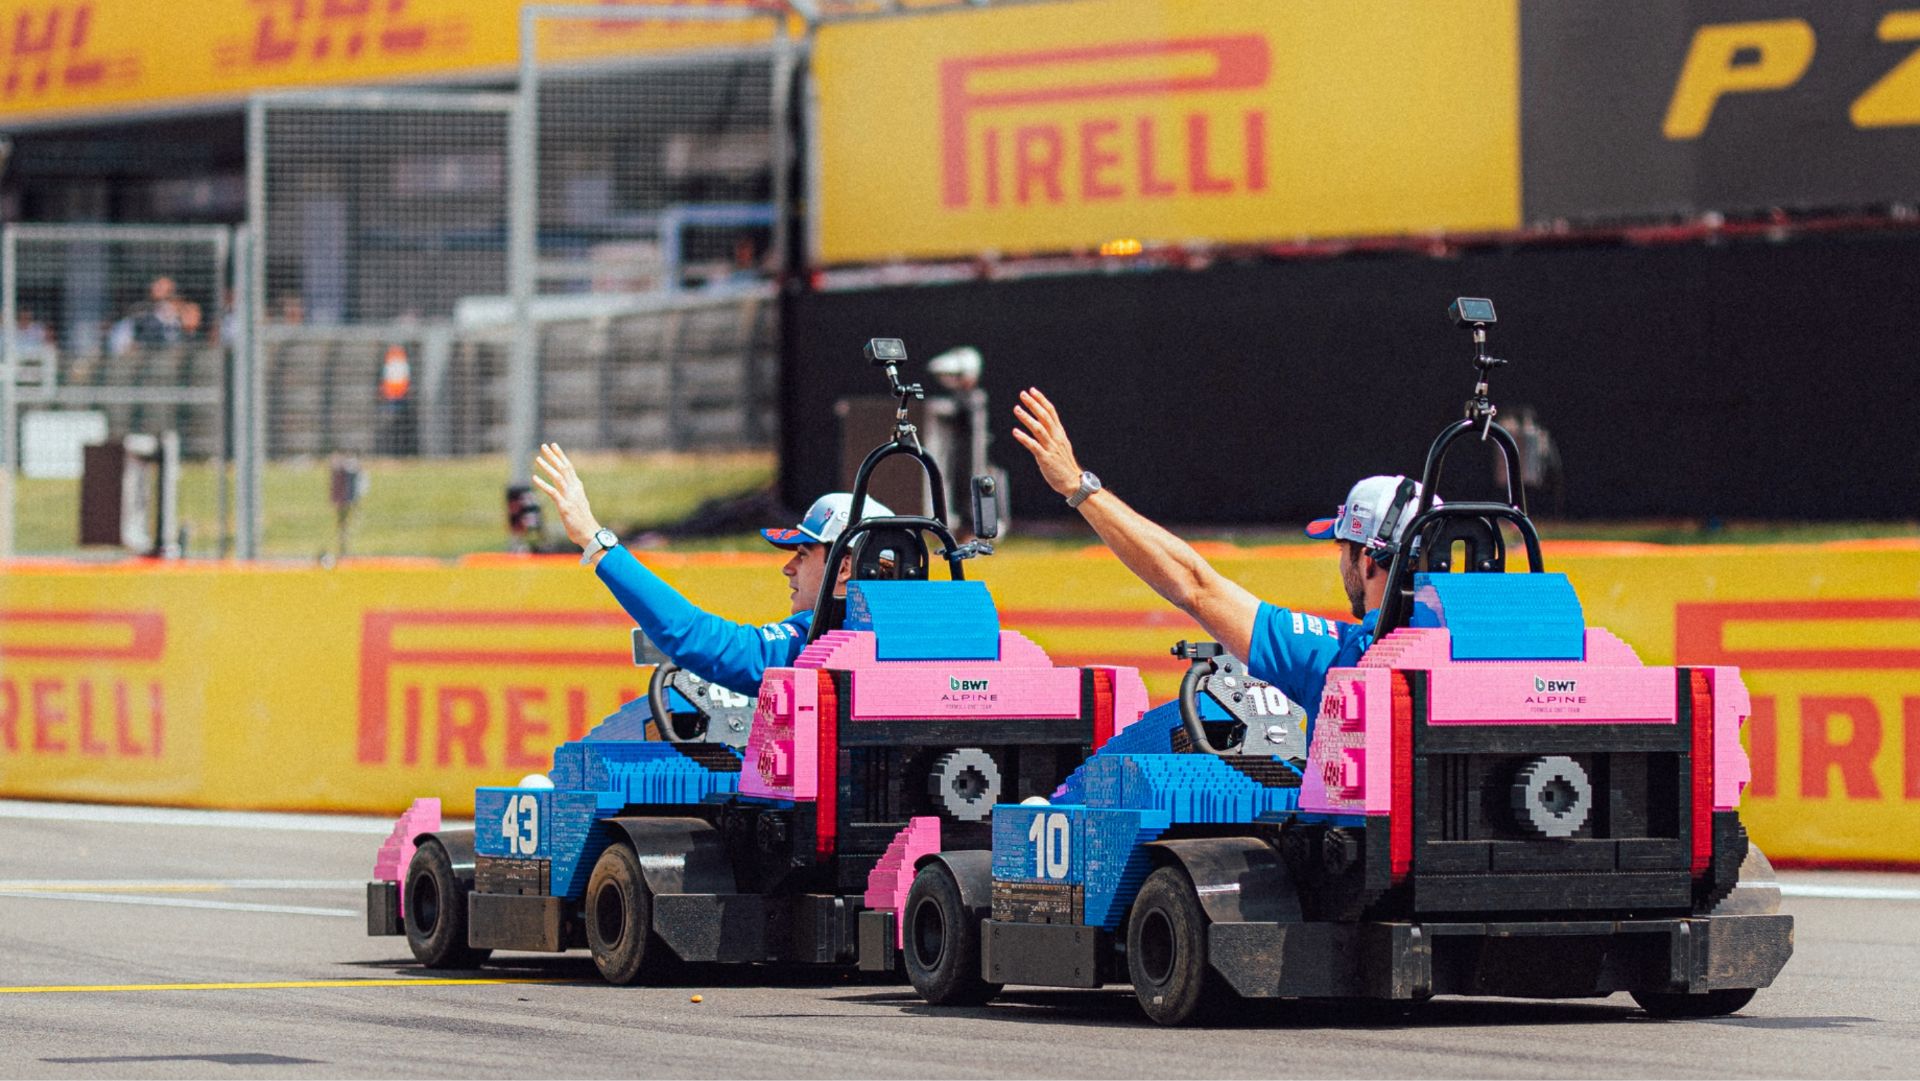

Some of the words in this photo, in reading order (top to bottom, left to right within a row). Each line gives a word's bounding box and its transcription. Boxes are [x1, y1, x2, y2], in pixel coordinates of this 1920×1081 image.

[940, 34, 1273, 210] PIRELLI
[962, 680, 988, 690] BWT
[1246, 685, 1289, 715] 10
[1548, 680, 1576, 692] BWT
[502, 795, 538, 855] 43
[1029, 813, 1069, 879] 10
